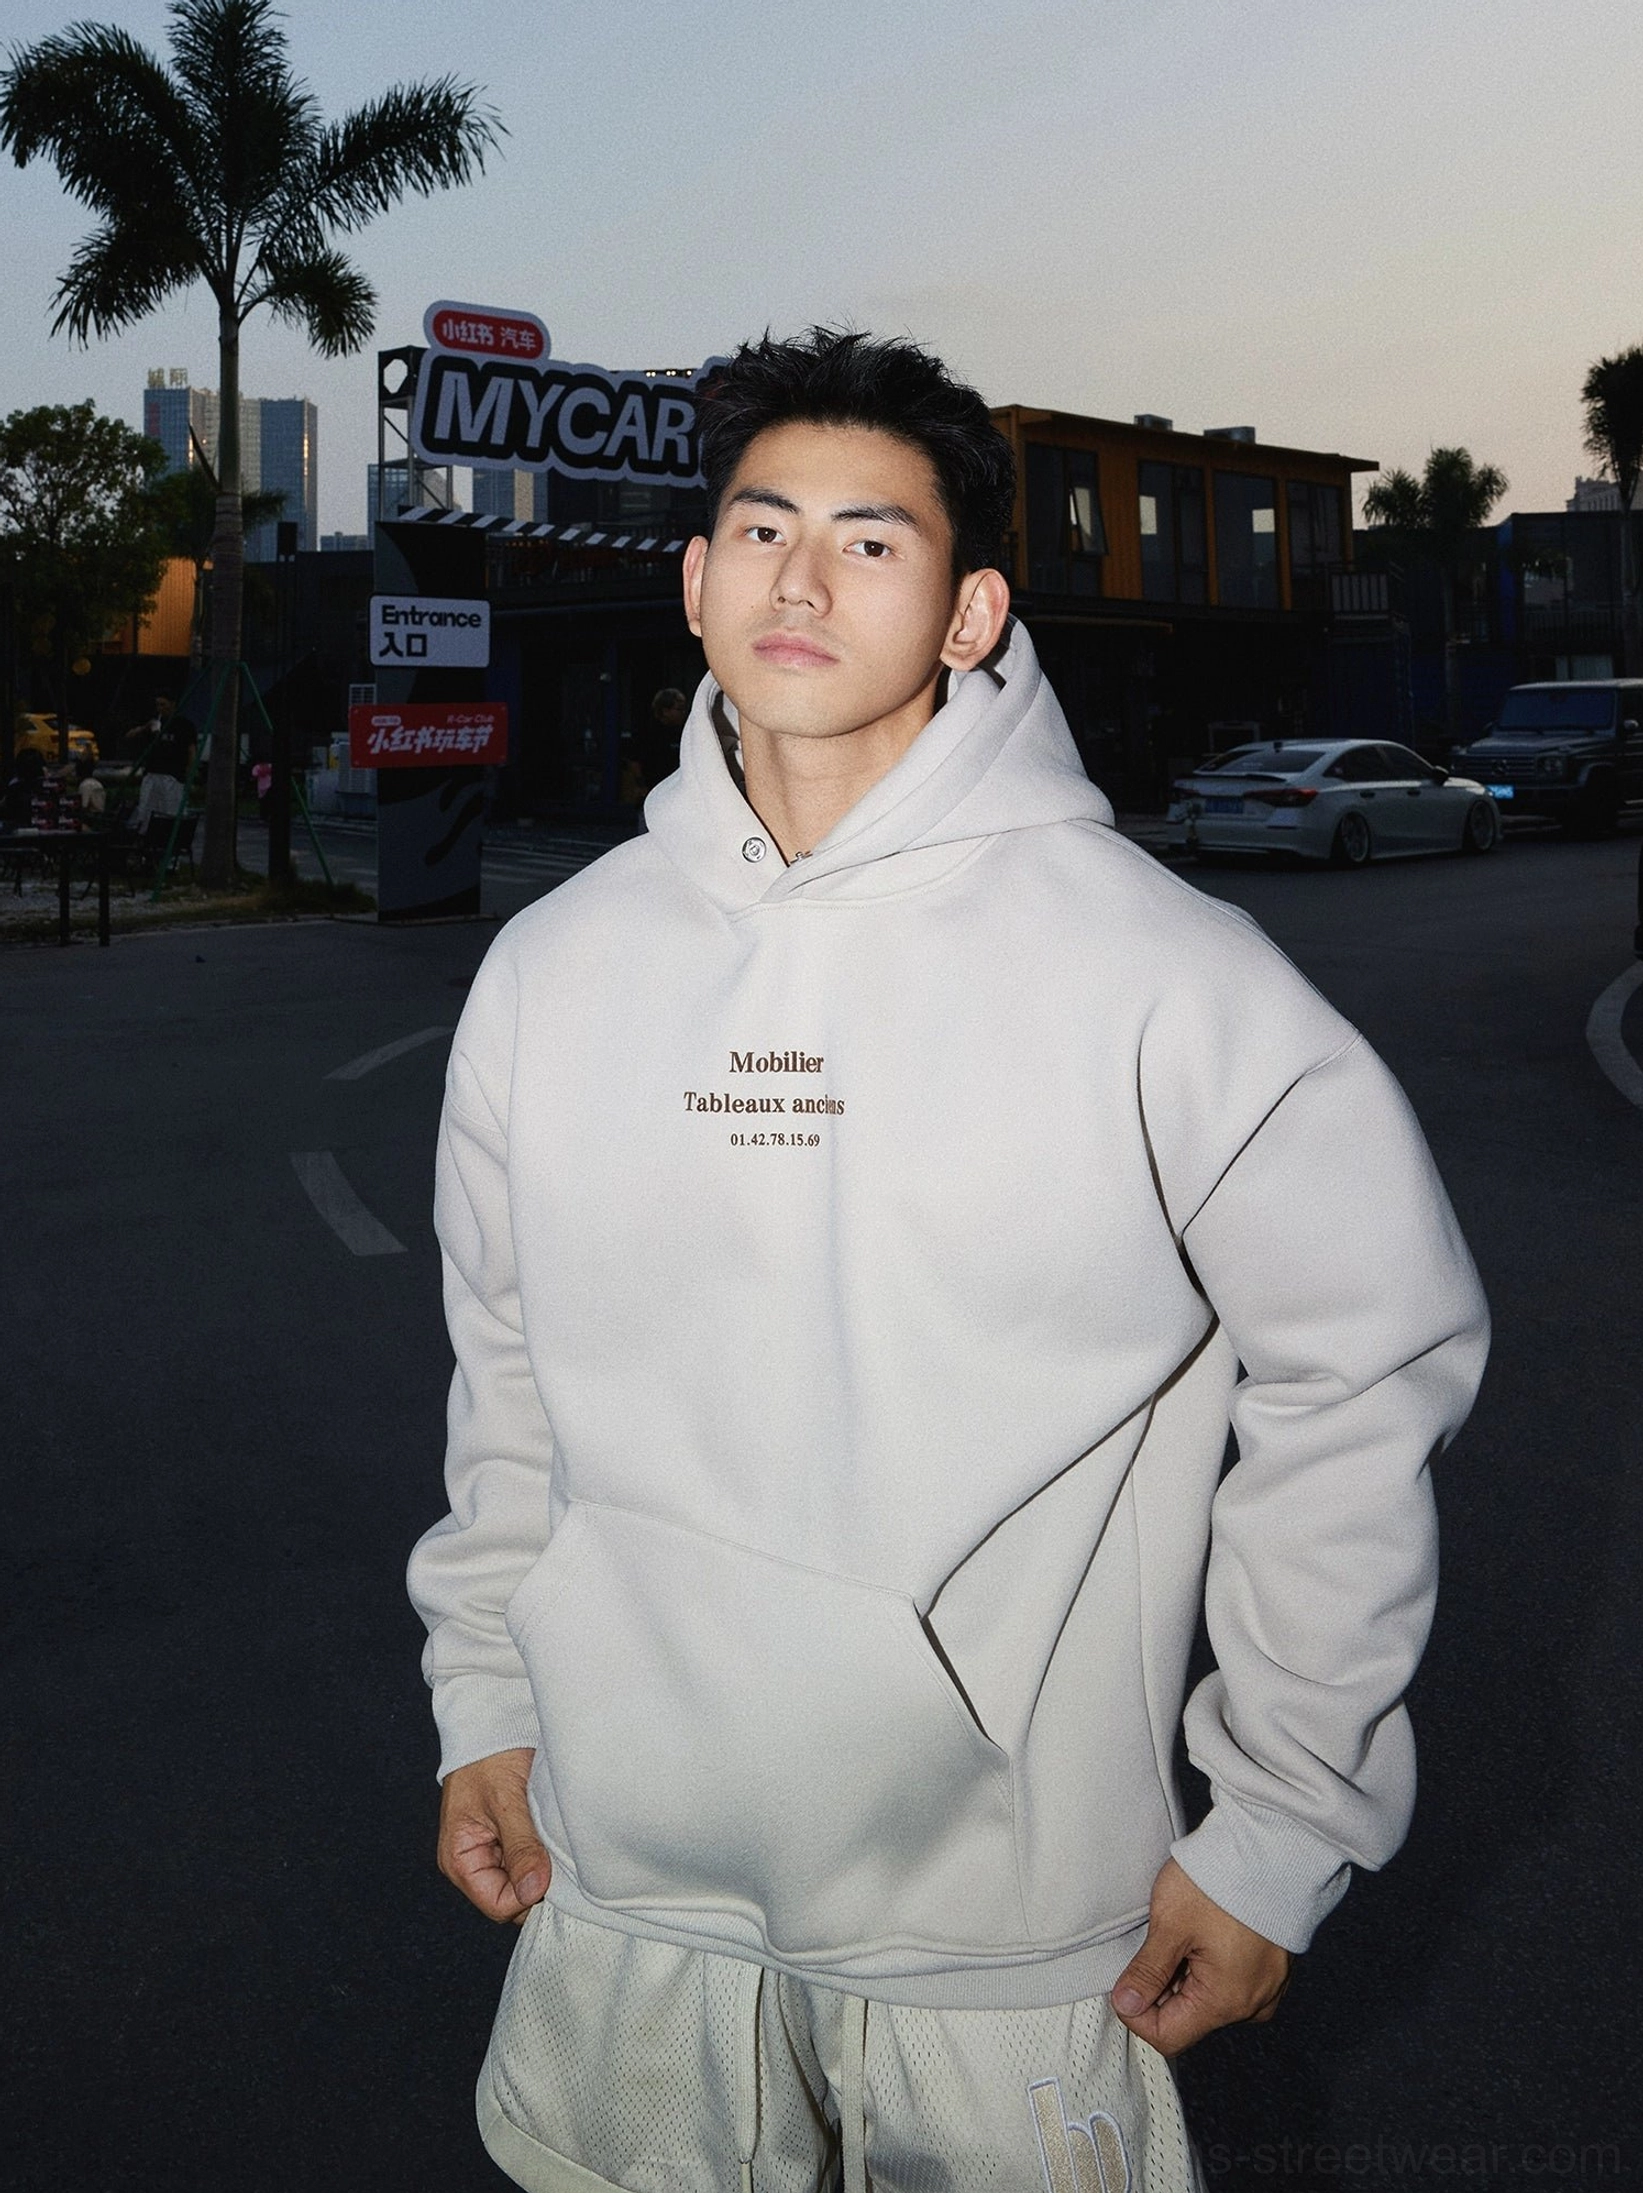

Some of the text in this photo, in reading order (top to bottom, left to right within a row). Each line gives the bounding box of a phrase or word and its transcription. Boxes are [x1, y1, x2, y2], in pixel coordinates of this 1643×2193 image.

[442, 319, 537, 352] 小红书 汽车
[434, 371, 696, 465] MYCAR
[381, 604, 482, 628] Entrance
[379, 632, 427, 658] 入口
[367, 723, 493, 754] 小红书玩车节
[729, 1050, 825, 1074] Mobilier
[683, 1090, 786, 1114] Tableaux
[730, 1132, 821, 1148] 01.42.78.15.69
